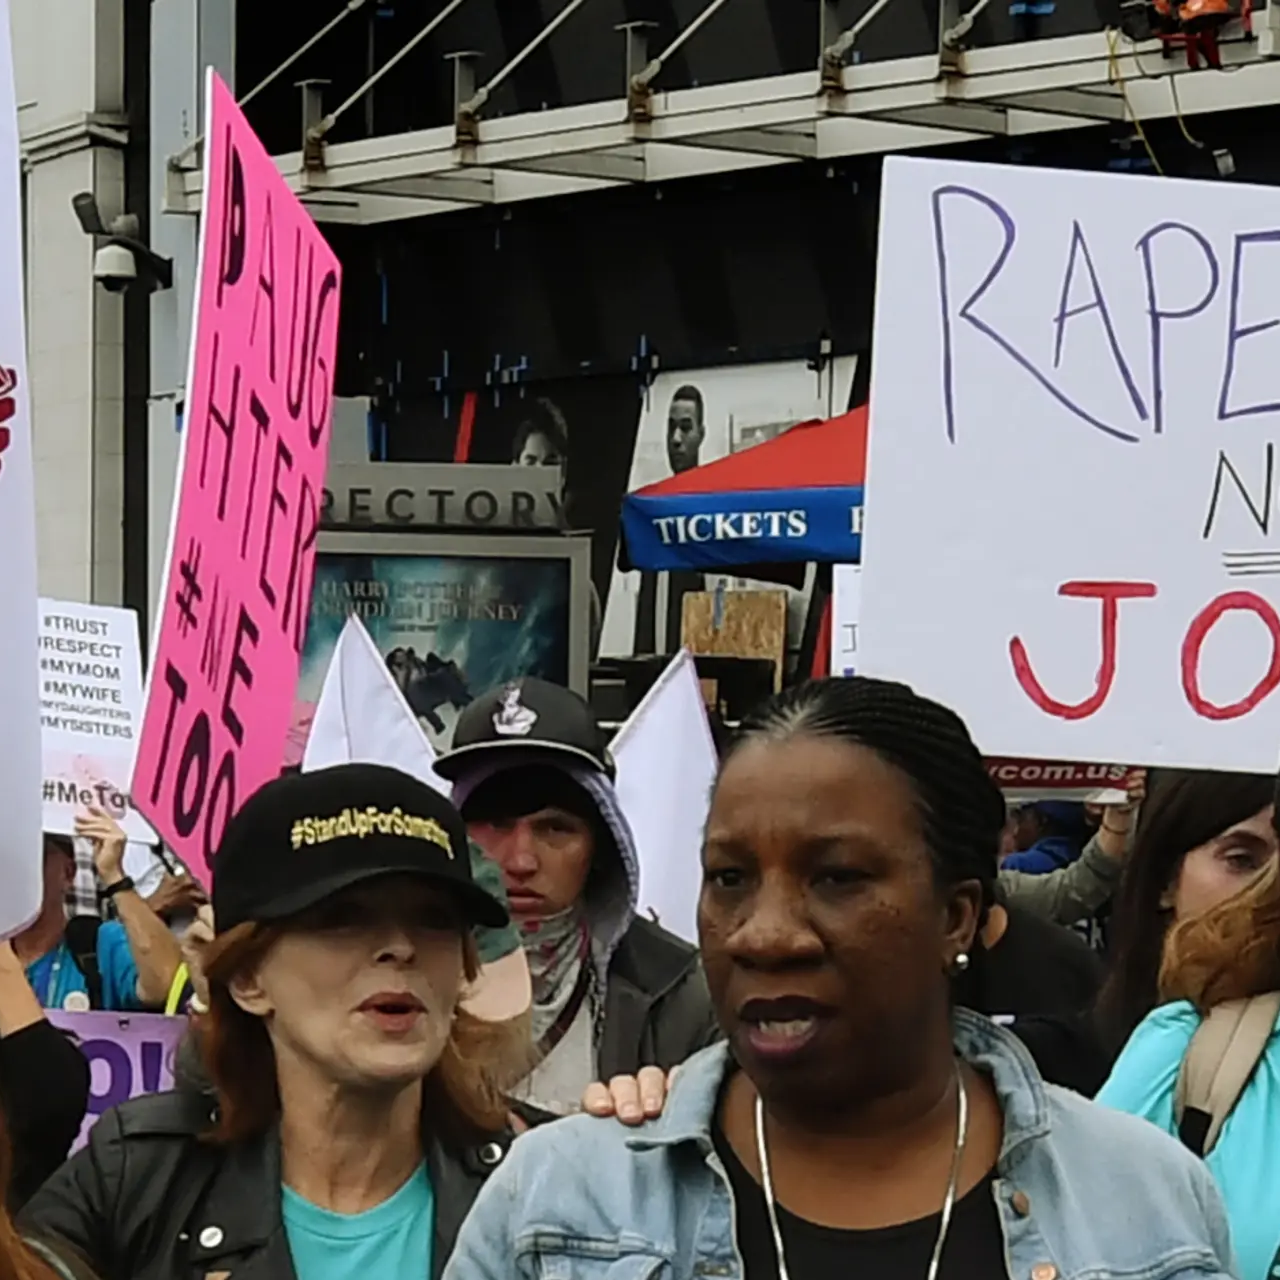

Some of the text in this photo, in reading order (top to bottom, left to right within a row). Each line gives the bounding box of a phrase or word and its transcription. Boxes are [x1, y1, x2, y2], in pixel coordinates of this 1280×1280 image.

[652, 509, 808, 545] TICKETS
[44, 614, 109, 638] #TRUST
[40, 658, 122, 681] #MYMOM
[43, 680, 123, 704] #MYWIFE
